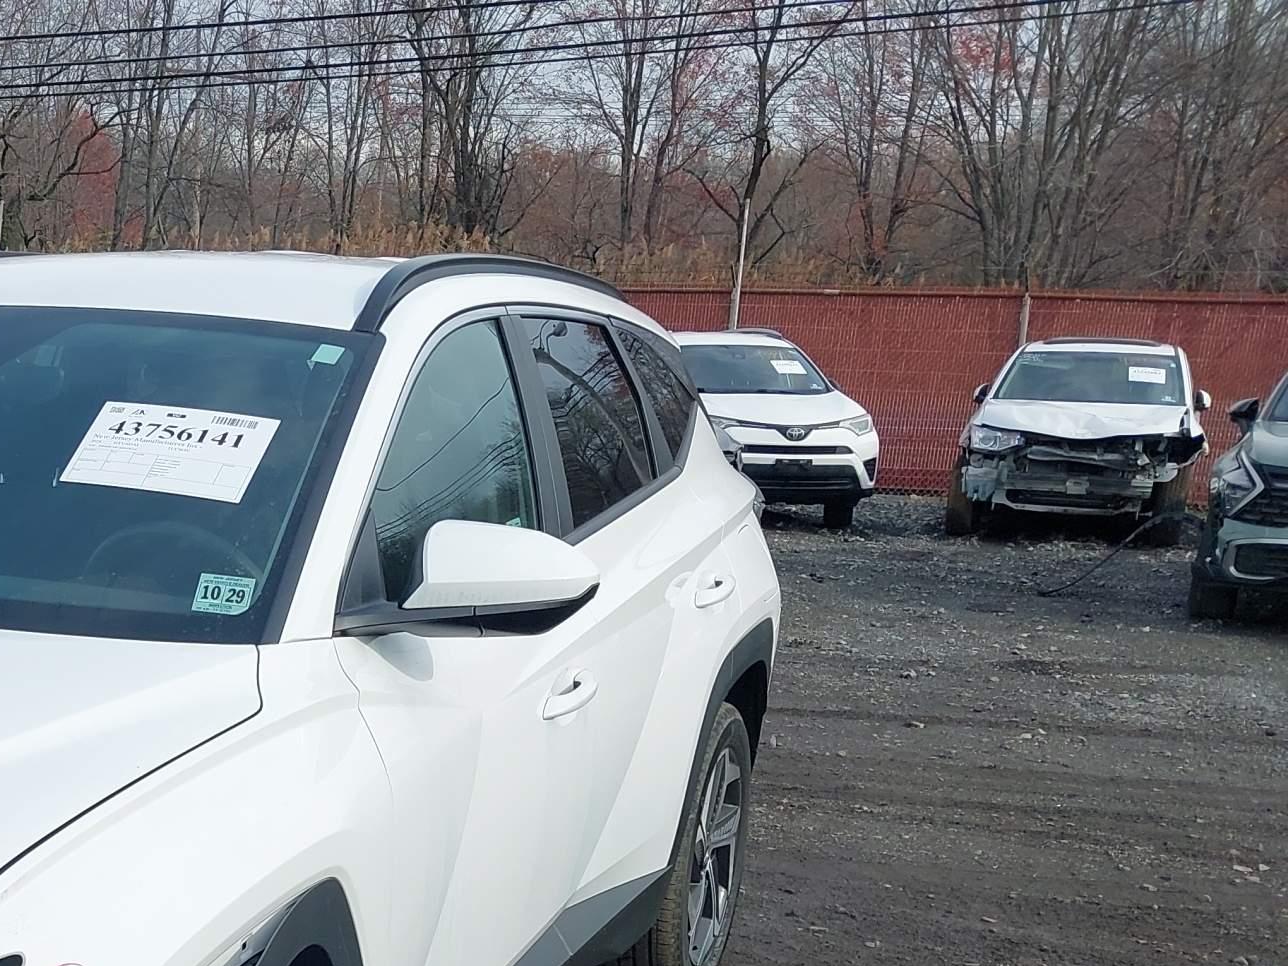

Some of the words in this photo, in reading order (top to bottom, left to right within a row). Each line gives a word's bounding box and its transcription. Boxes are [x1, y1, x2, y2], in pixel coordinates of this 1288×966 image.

[108, 420, 245, 448] 43756141
[200, 584, 222, 600] 10
[224, 588, 246, 604] 29
